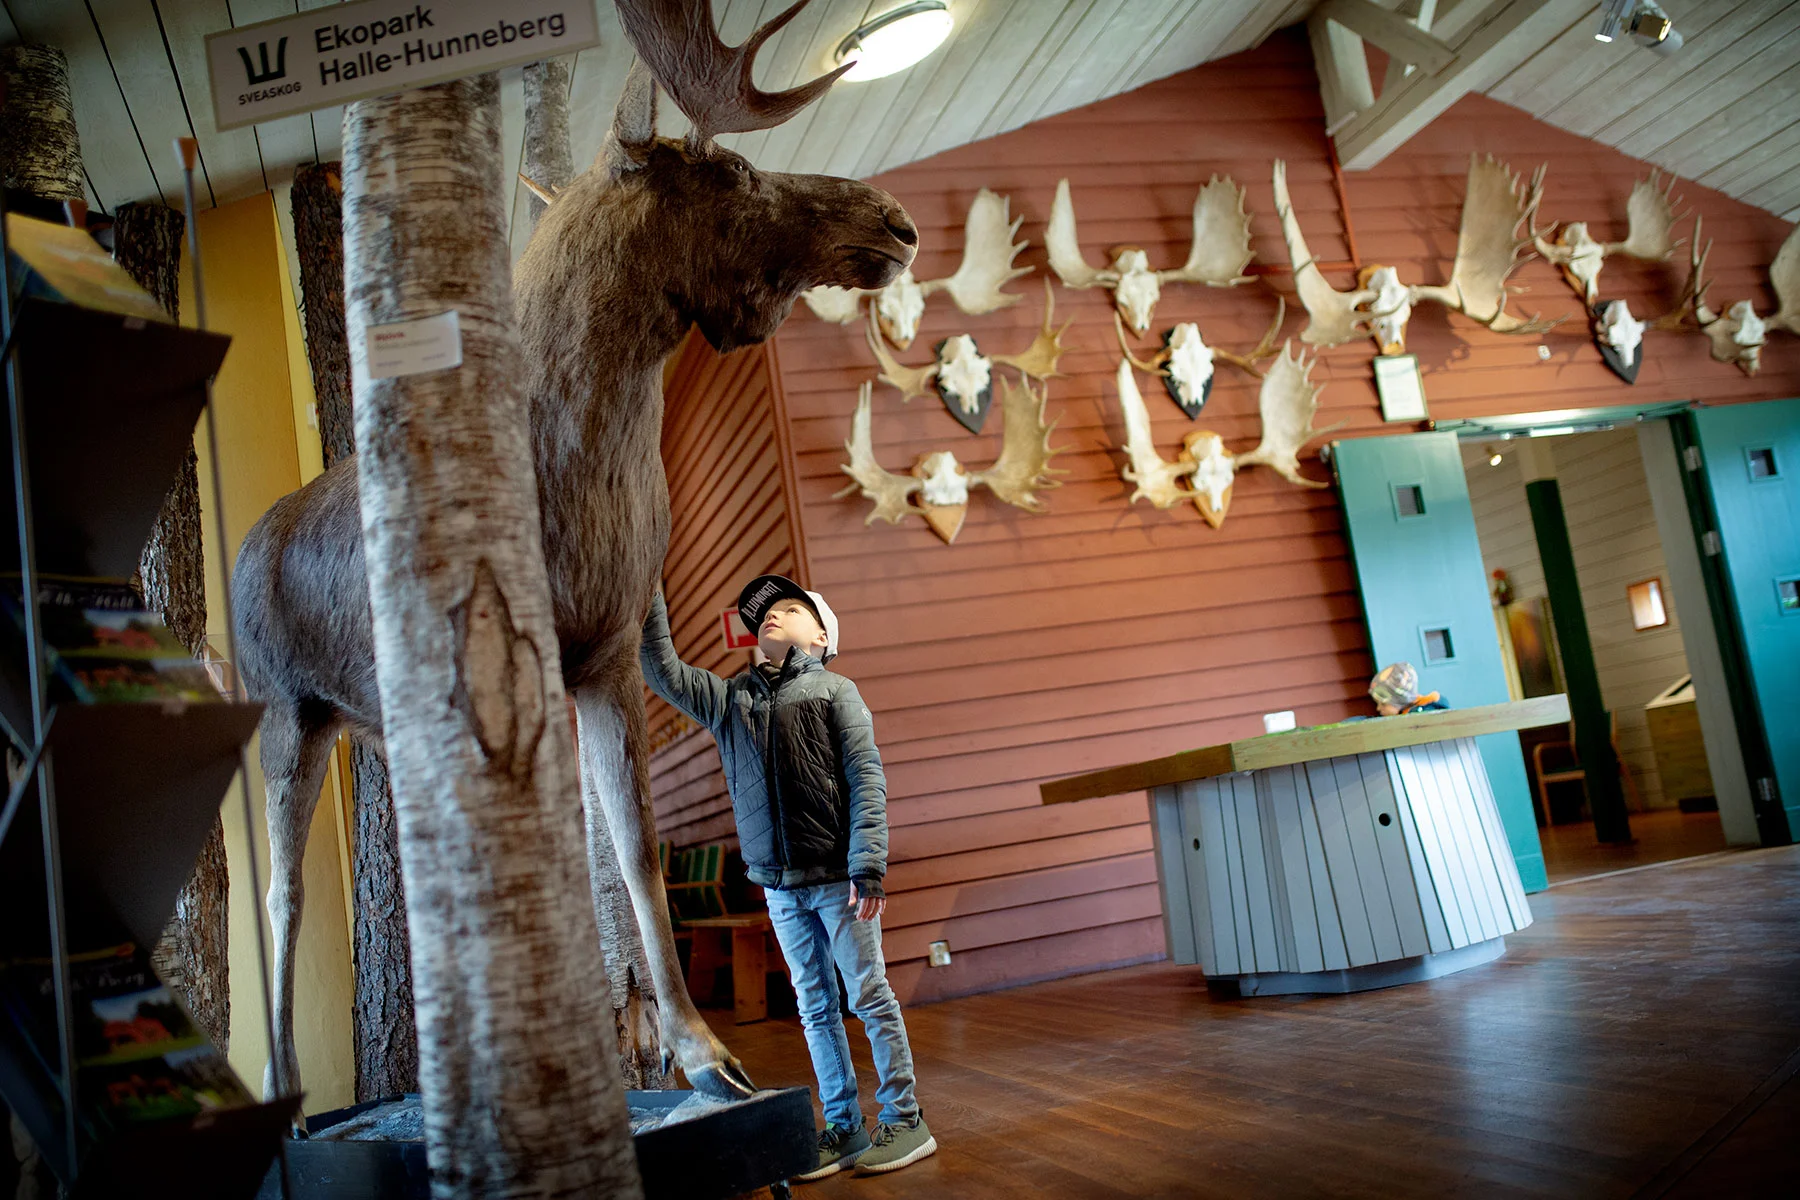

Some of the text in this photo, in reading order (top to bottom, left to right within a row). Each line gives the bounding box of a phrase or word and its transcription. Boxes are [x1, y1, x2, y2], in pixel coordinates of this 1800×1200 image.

[314, 5, 435, 53] Ekopark
[319, 12, 566, 86] Halle-Hunneberg
[238, 81, 302, 105] SVEASKOG
